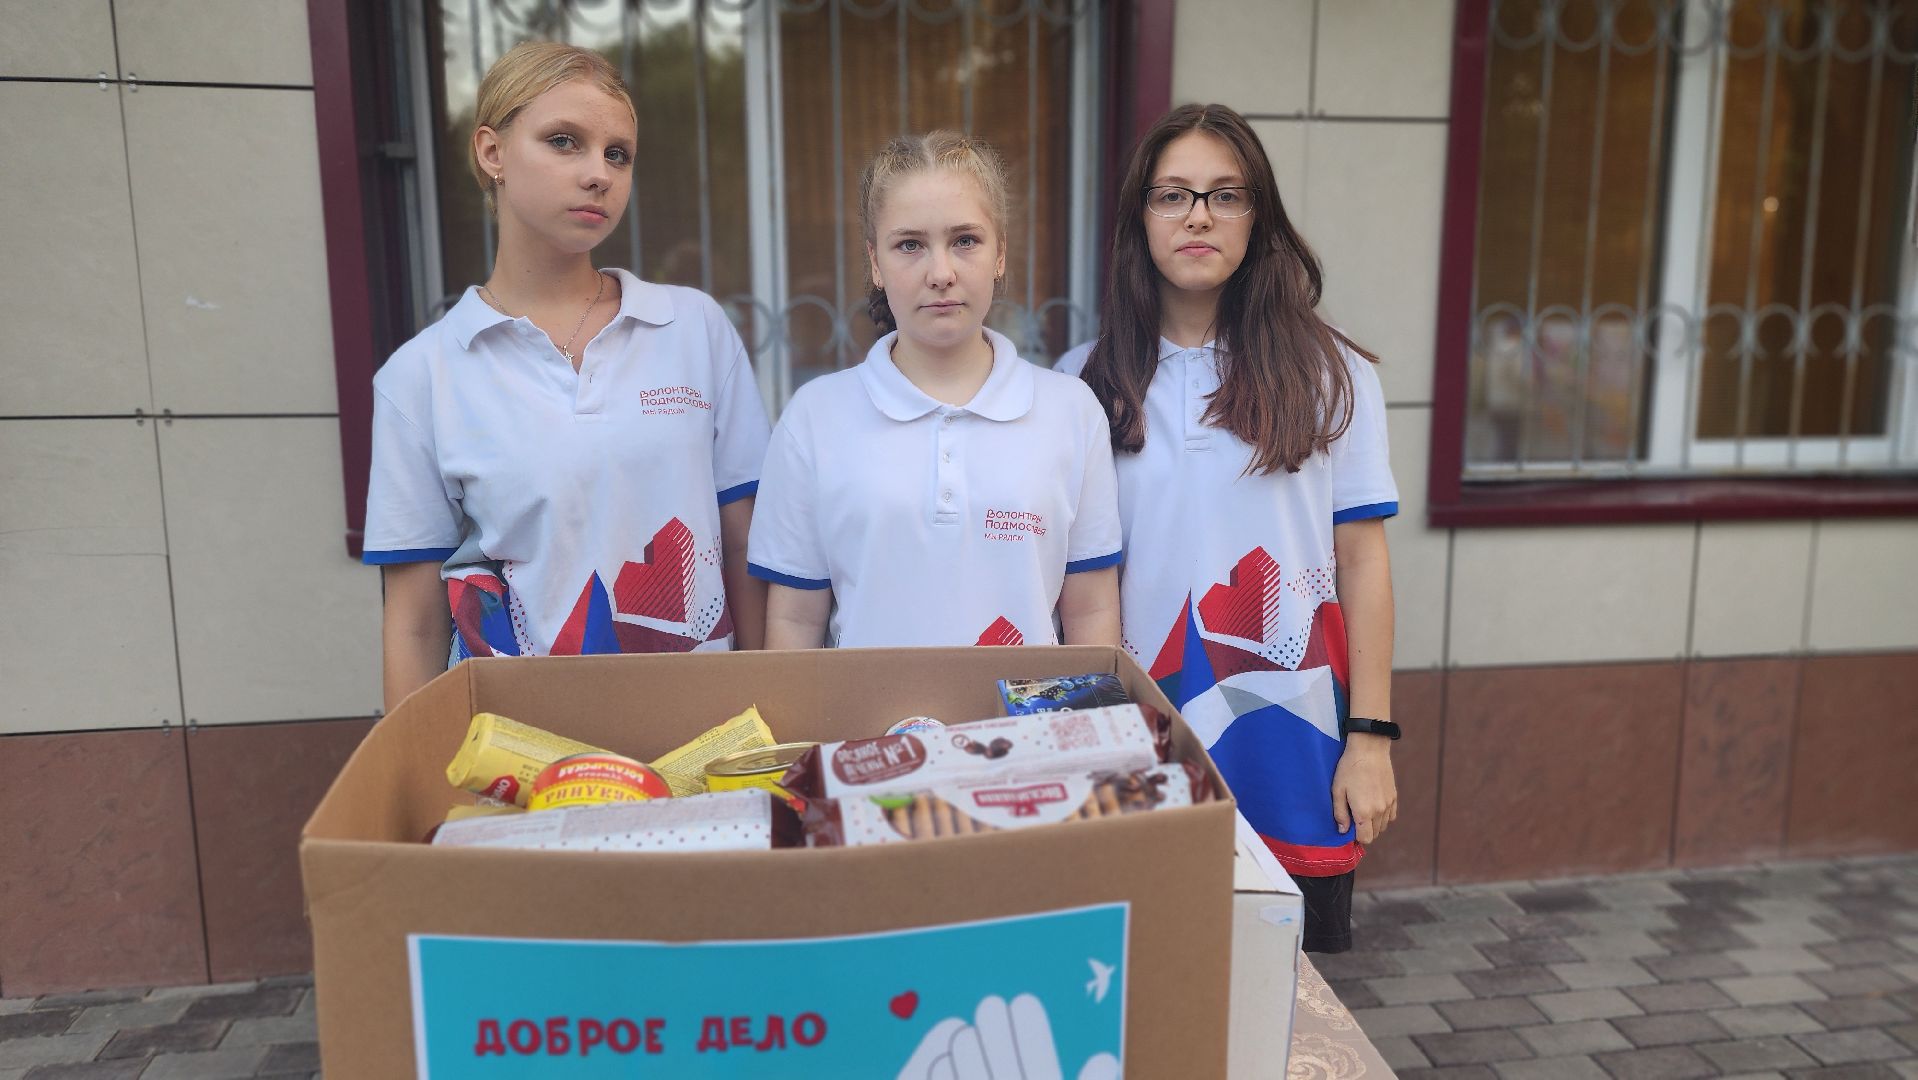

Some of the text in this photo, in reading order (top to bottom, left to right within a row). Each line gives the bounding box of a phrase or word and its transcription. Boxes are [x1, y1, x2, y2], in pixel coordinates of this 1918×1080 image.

[545, 784, 638, 804] ОВЯДИНА
[474, 1012, 827, 1056] ДОБРОЕ ДЕЛО
